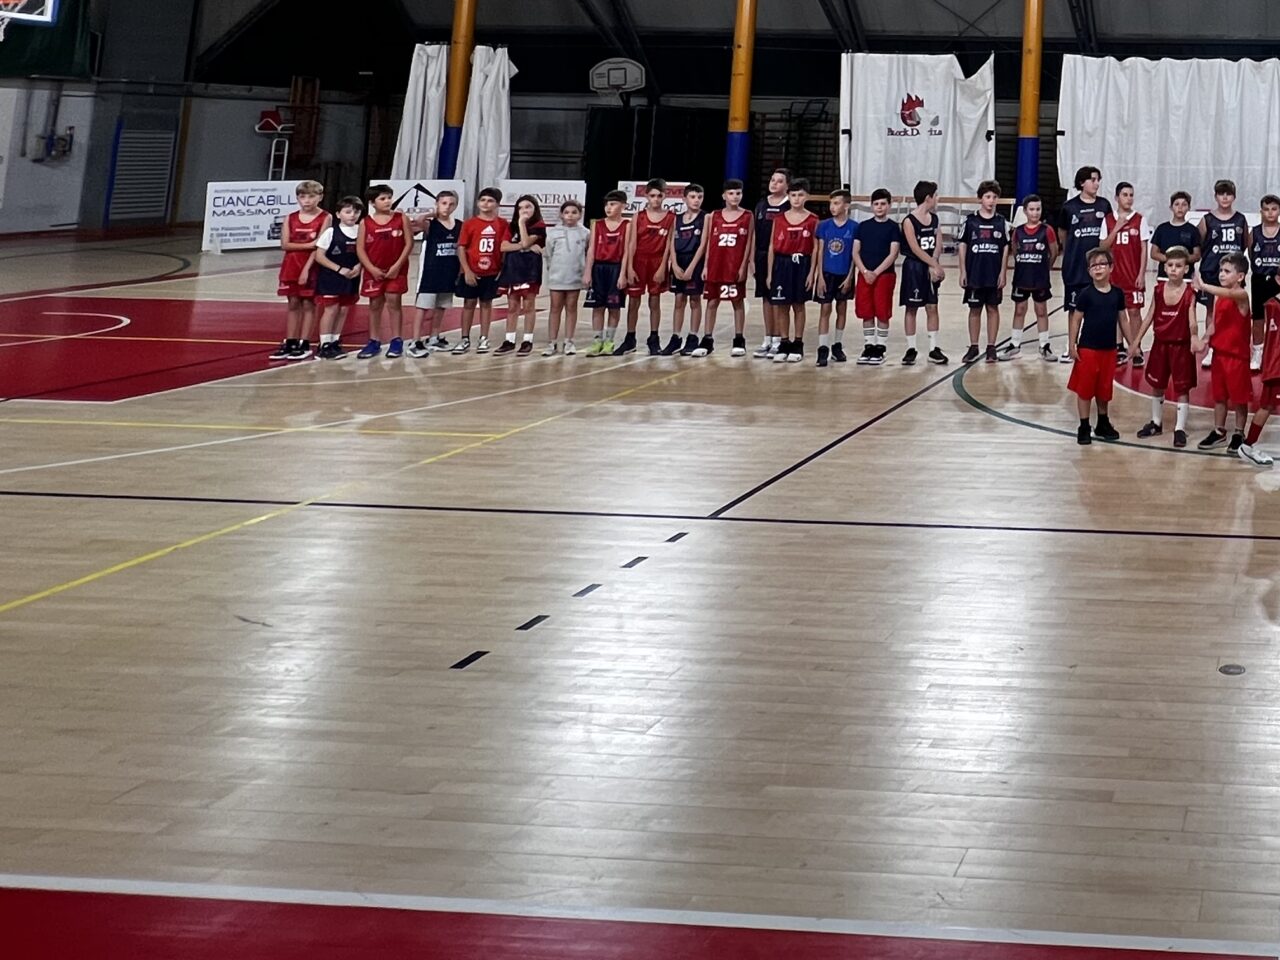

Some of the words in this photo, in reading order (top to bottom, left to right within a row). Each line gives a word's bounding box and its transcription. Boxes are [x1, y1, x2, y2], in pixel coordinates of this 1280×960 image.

[213, 195, 297, 207] CIANCABILL
[212, 208, 280, 217] MASSIMO
[718, 234, 737, 246] 25
[1116, 232, 1129, 244] 16
[1222, 228, 1235, 242] 18
[479, 238, 494, 252] 03
[921, 237, 935, 249] 52
[720, 285, 738, 298] 25
